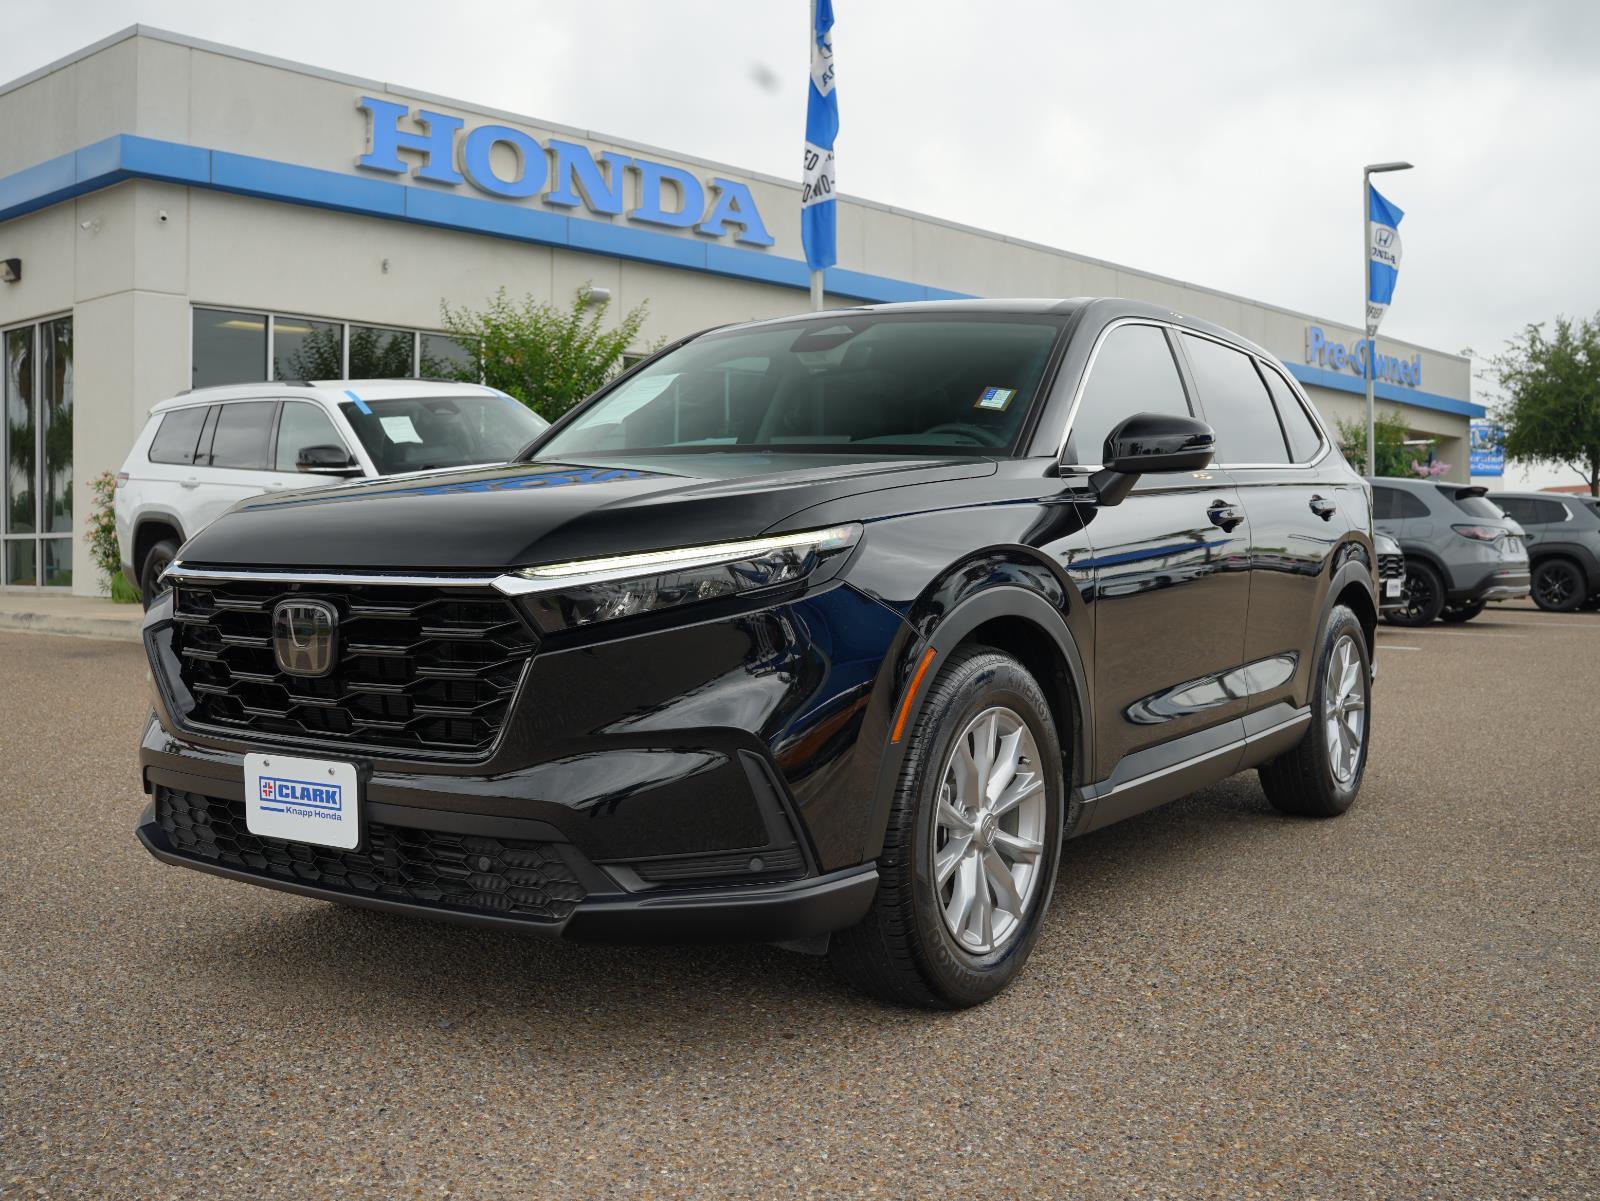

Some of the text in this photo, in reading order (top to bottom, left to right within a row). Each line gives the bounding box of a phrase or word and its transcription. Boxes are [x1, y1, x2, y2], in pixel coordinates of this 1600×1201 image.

[355, 95, 775, 247] HONDA
[277, 783, 338, 805] CLARK
[285, 806, 342, 821] Knapp Honda
